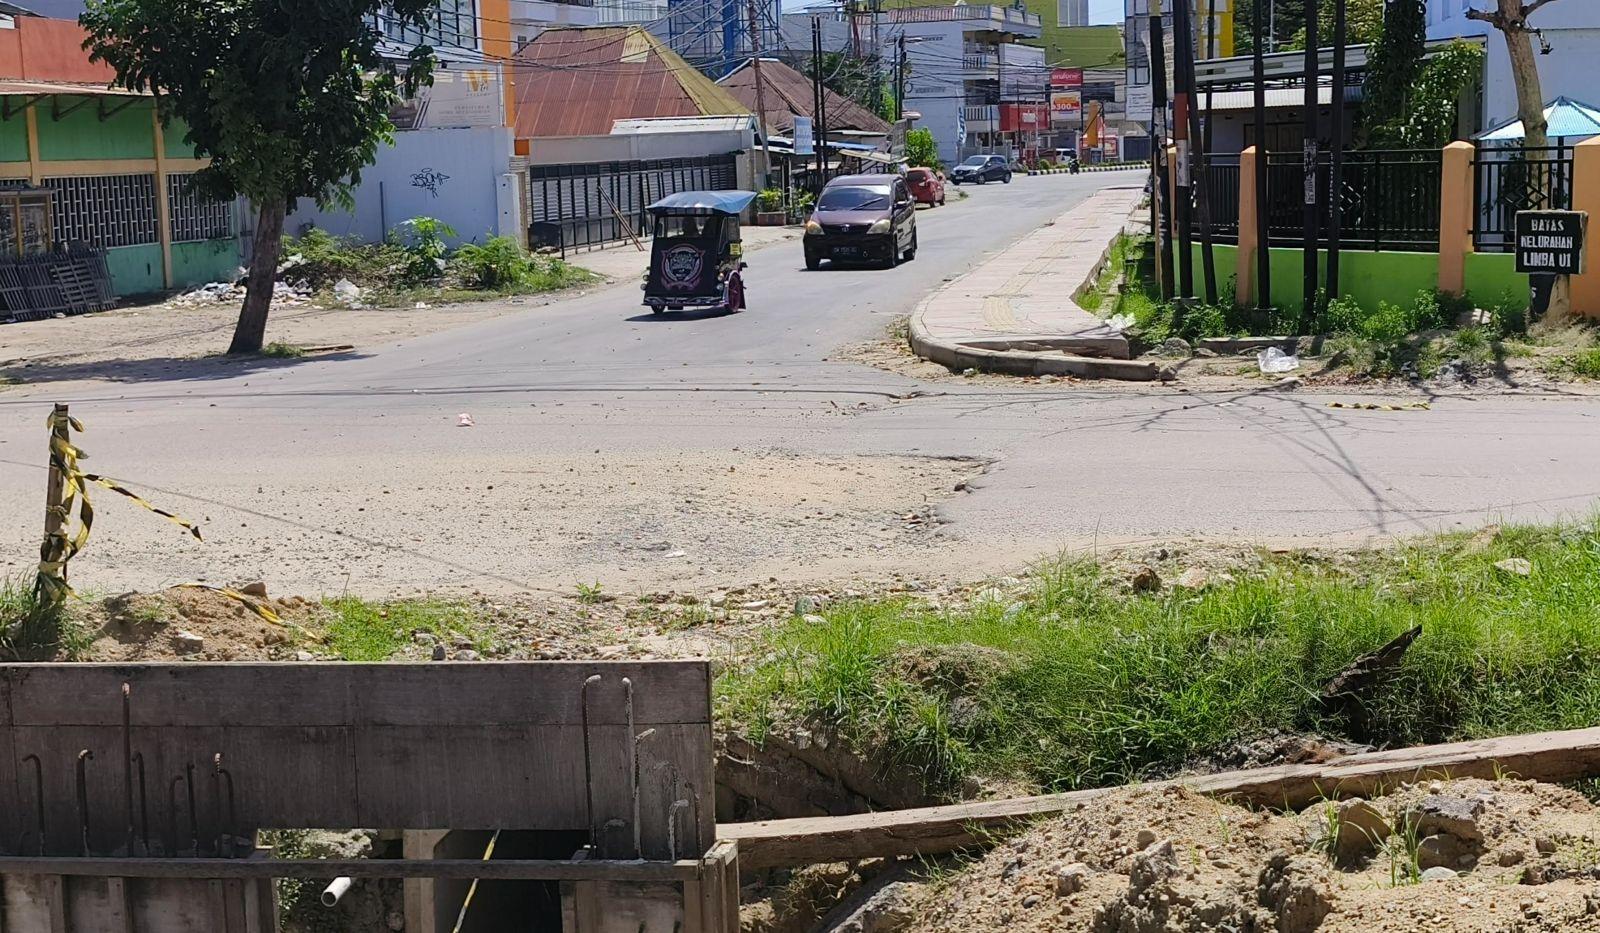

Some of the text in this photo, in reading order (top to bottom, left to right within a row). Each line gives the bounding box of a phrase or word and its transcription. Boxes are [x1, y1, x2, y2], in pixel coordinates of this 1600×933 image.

[1531, 219, 1564, 231] BATAS
[1520, 235, 1573, 249] KELURAHAN
[1523, 252, 1555, 267] LIMBA
